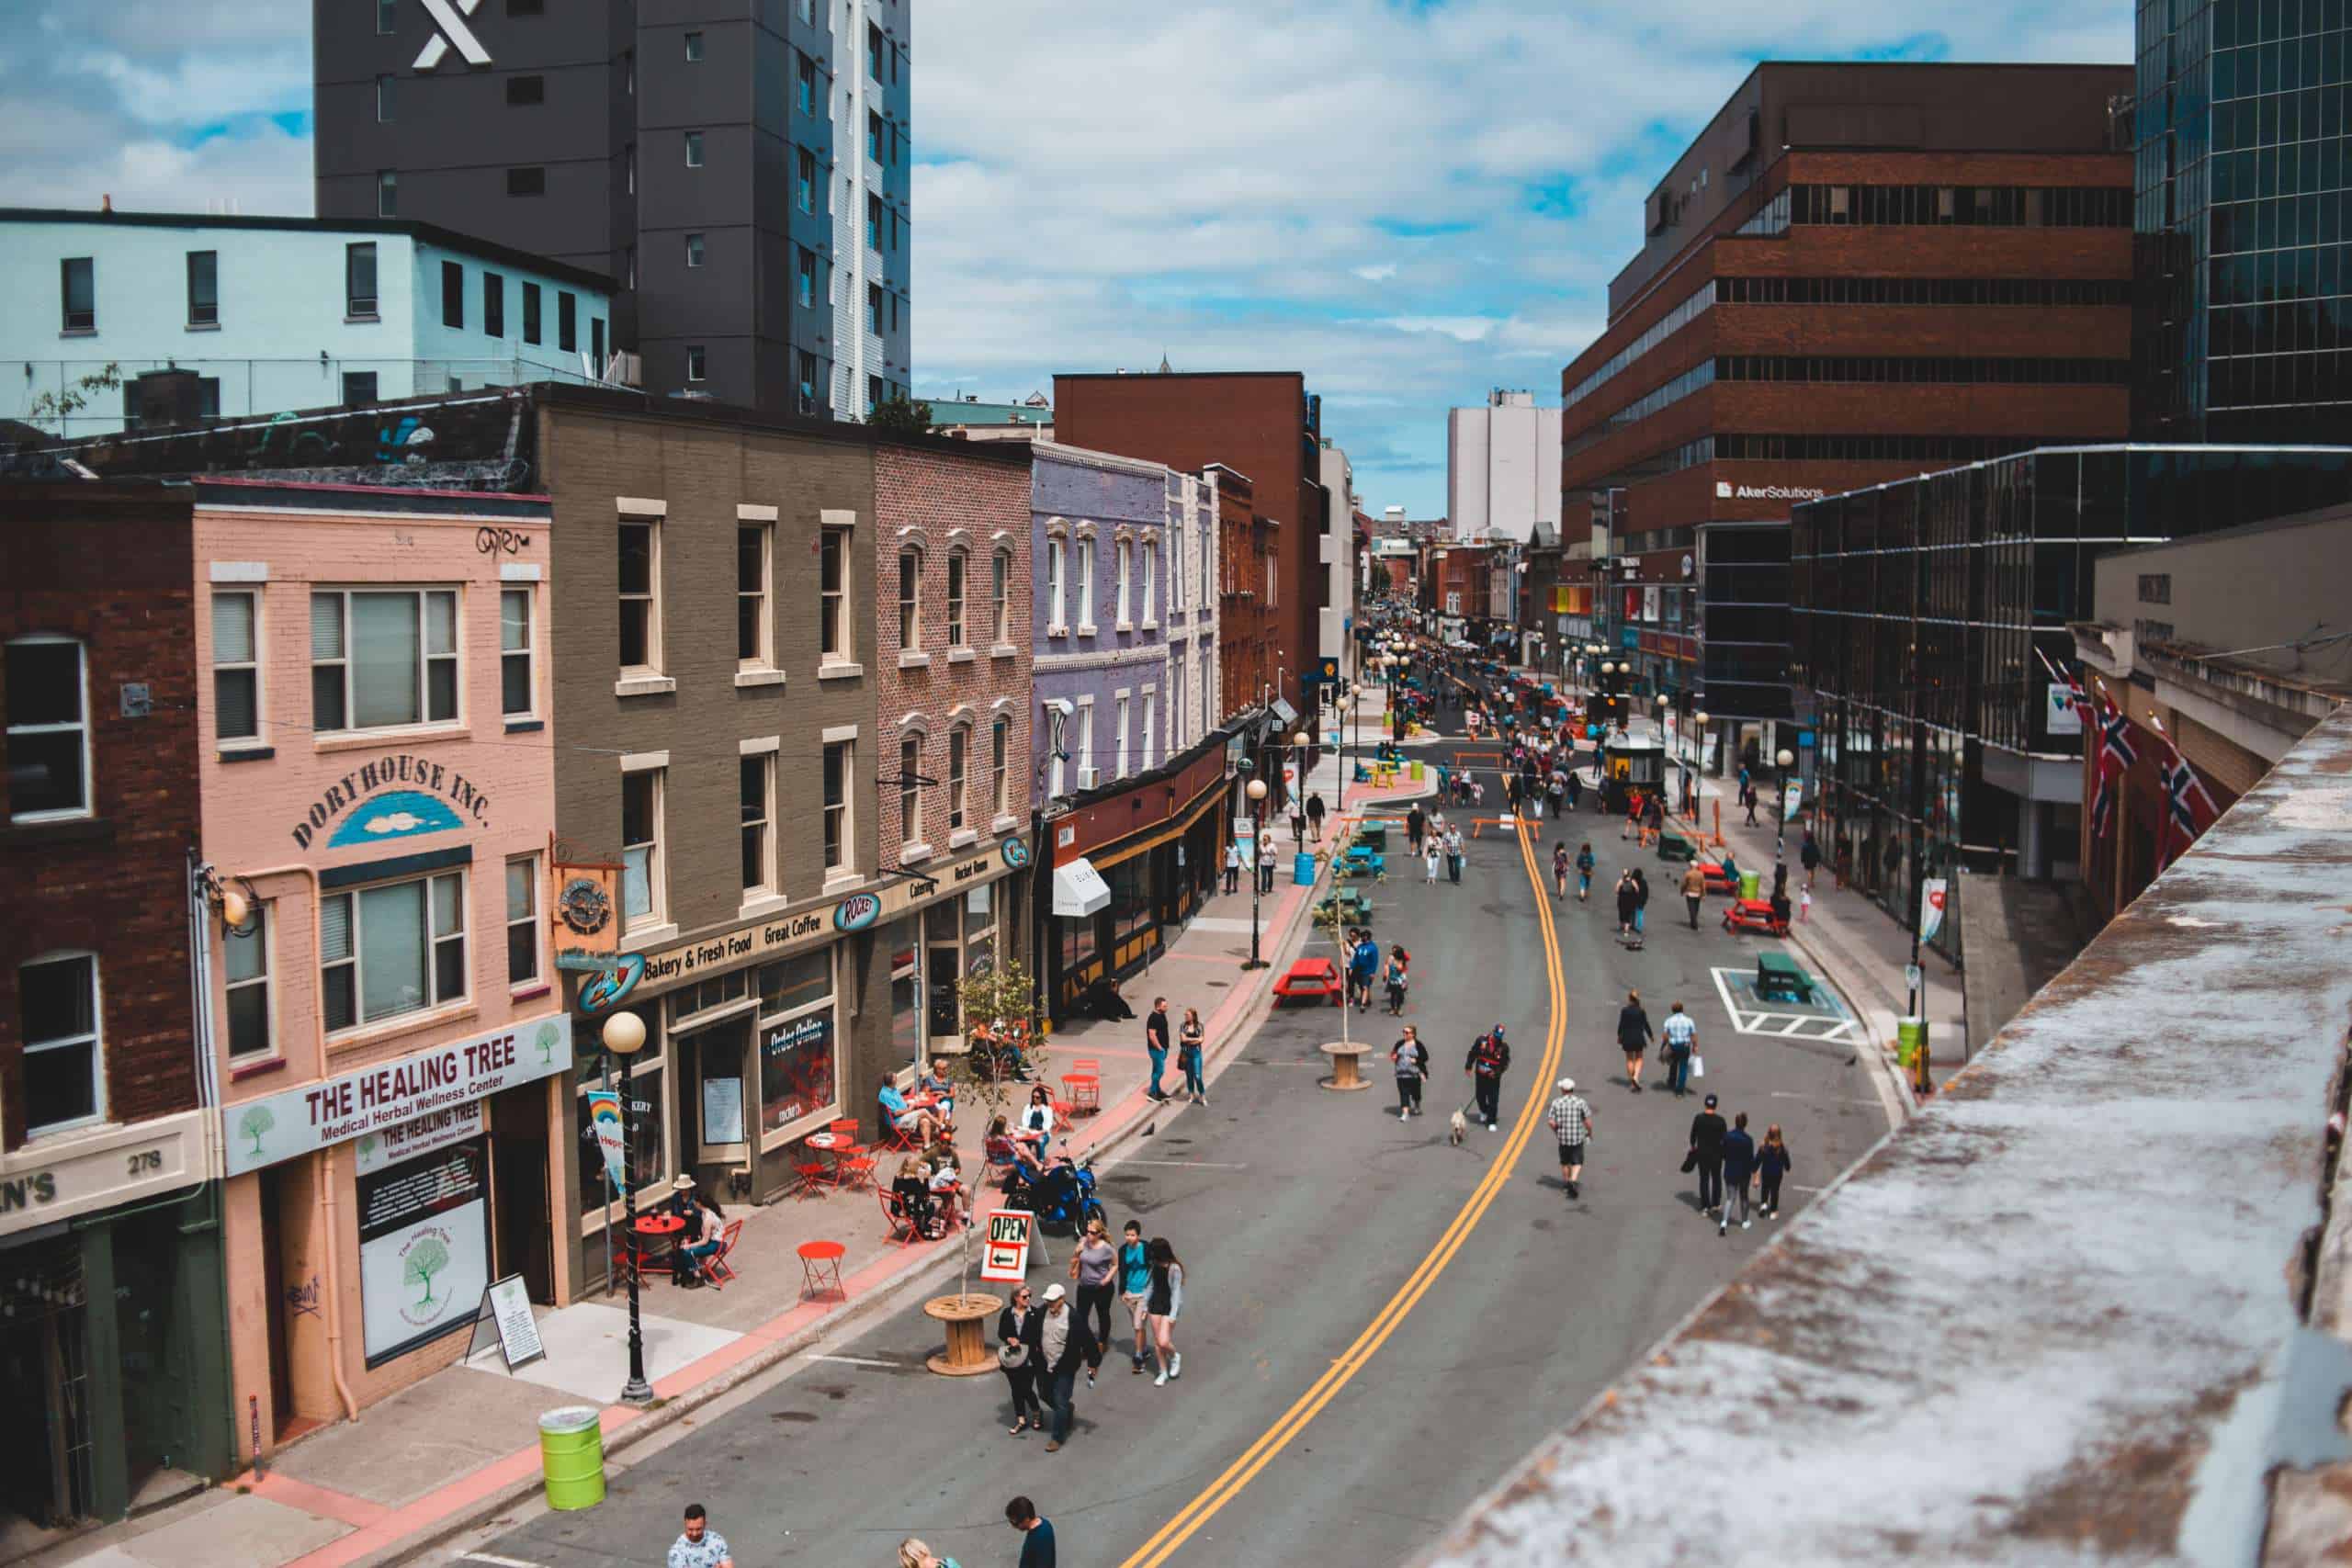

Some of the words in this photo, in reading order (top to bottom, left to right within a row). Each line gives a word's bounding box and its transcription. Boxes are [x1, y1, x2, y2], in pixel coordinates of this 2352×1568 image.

[1736, 485, 1824, 500] AkerSolutions
[291, 755, 445, 851] DORYHOUSE
[450, 773, 489, 828] INC.
[764, 926, 790, 945] Great
[792, 915, 821, 937] Coffee
[843, 897, 873, 927] ROCKET
[644, 955, 683, 981] Bakery
[684, 950, 695, 968] &
[697, 941, 725, 966] Fresh
[728, 932, 752, 956] Food
[771, 1028, 795, 1055] Order
[796, 1017, 823, 1046] Online
[305, 1081, 353, 1126] THE
[360, 1052, 457, 1110] HEALING
[464, 1034, 515, 1077] TREE
[322, 1115, 369, 1143] Medical
[373, 1100, 413, 1125] Herbal
[416, 1086, 465, 1111] Wellness
[468, 1075, 504, 1095] Center
[382, 1123, 404, 1148] THE
[406, 1107, 452, 1140] HEALING
[454, 1103, 480, 1122] TREE
[128, 1150, 161, 1175] 278
[990, 1216, 1029, 1242] OPEN
